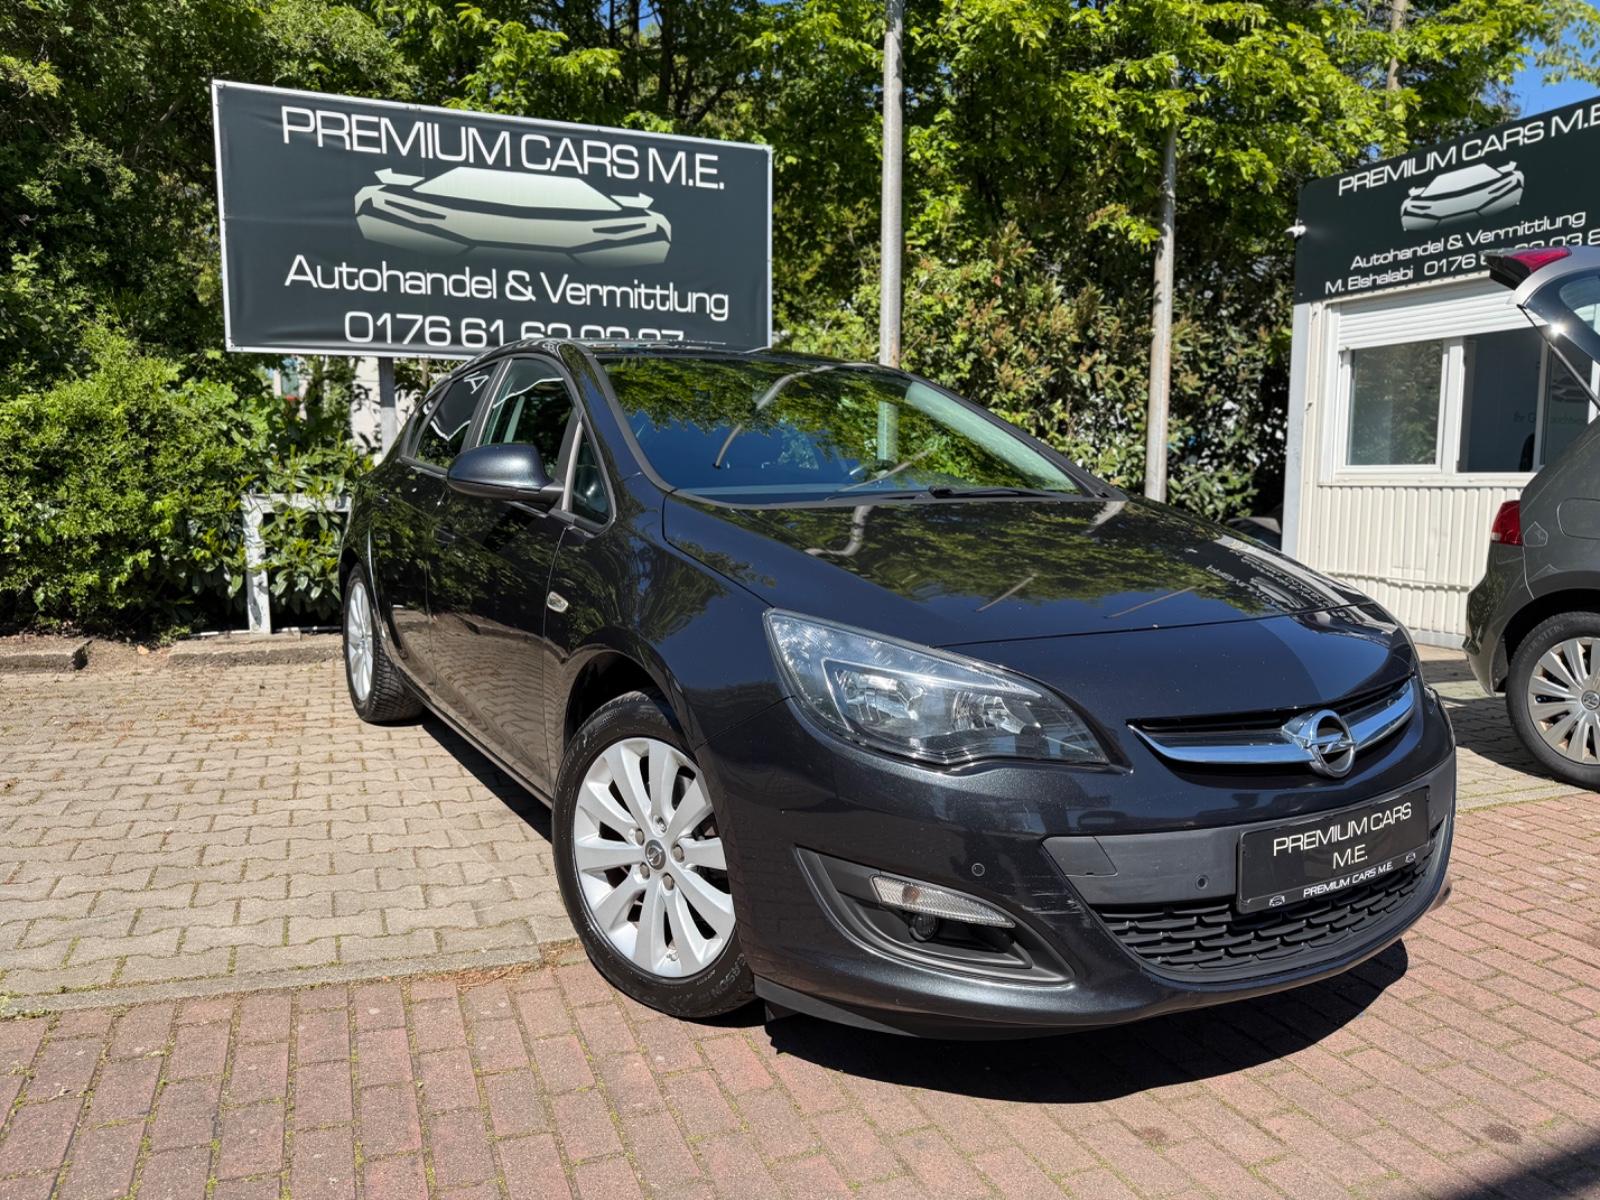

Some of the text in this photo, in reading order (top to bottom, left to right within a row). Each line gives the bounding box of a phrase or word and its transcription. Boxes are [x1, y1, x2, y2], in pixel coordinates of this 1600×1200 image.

[281, 105, 725, 190] PREMIUM CARS M.E.
[1338, 145, 1457, 197] PREMIUM
[1461, 120, 1545, 161] CARS
[1350, 211, 1587, 270] Autohandel & Vermittlung
[284, 254, 729, 322] Autohandel & Vermittlung
[1325, 278, 1345, 294] M.
[1423, 253, 1476, 276] 0176
[344, 310, 452, 347] 0176
[460, 317, 504, 348] 61
[1273, 801, 1412, 857] PREMIUM CARS
[1332, 843, 1368, 870] M.E.
[1303, 876, 1350, 899] PREMIUM
[1352, 867, 1377, 884] CARS
